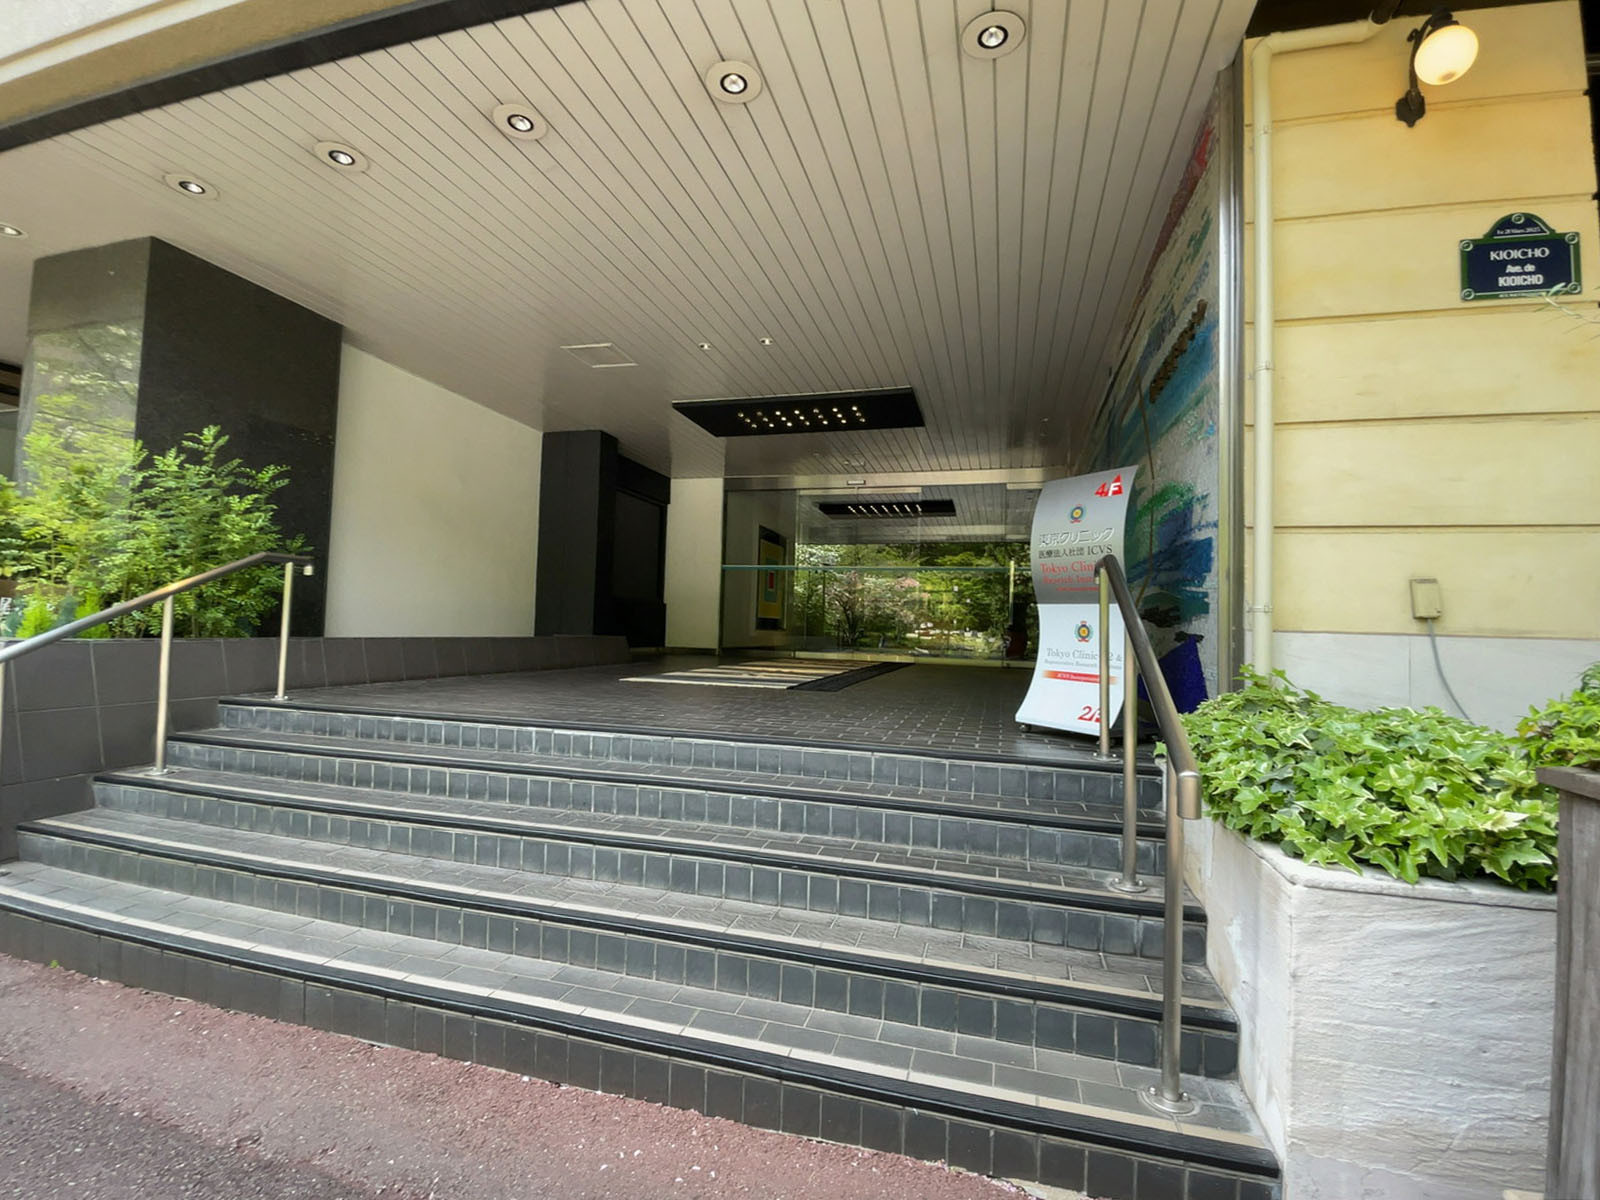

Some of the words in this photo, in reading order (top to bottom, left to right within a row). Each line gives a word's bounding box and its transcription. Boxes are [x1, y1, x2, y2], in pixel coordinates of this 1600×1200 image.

[1489, 247, 1550, 261] KIOICHO
[1498, 274, 1544, 287] KIOICHO
[1040, 527, 1115, 547] 東京クリニック
[1087, 544, 1113, 556] ICVS
[1040, 562, 1068, 574] Tokyo
[1046, 648, 1070, 660] Tokyo
[1072, 649, 1098, 660] Clinic
